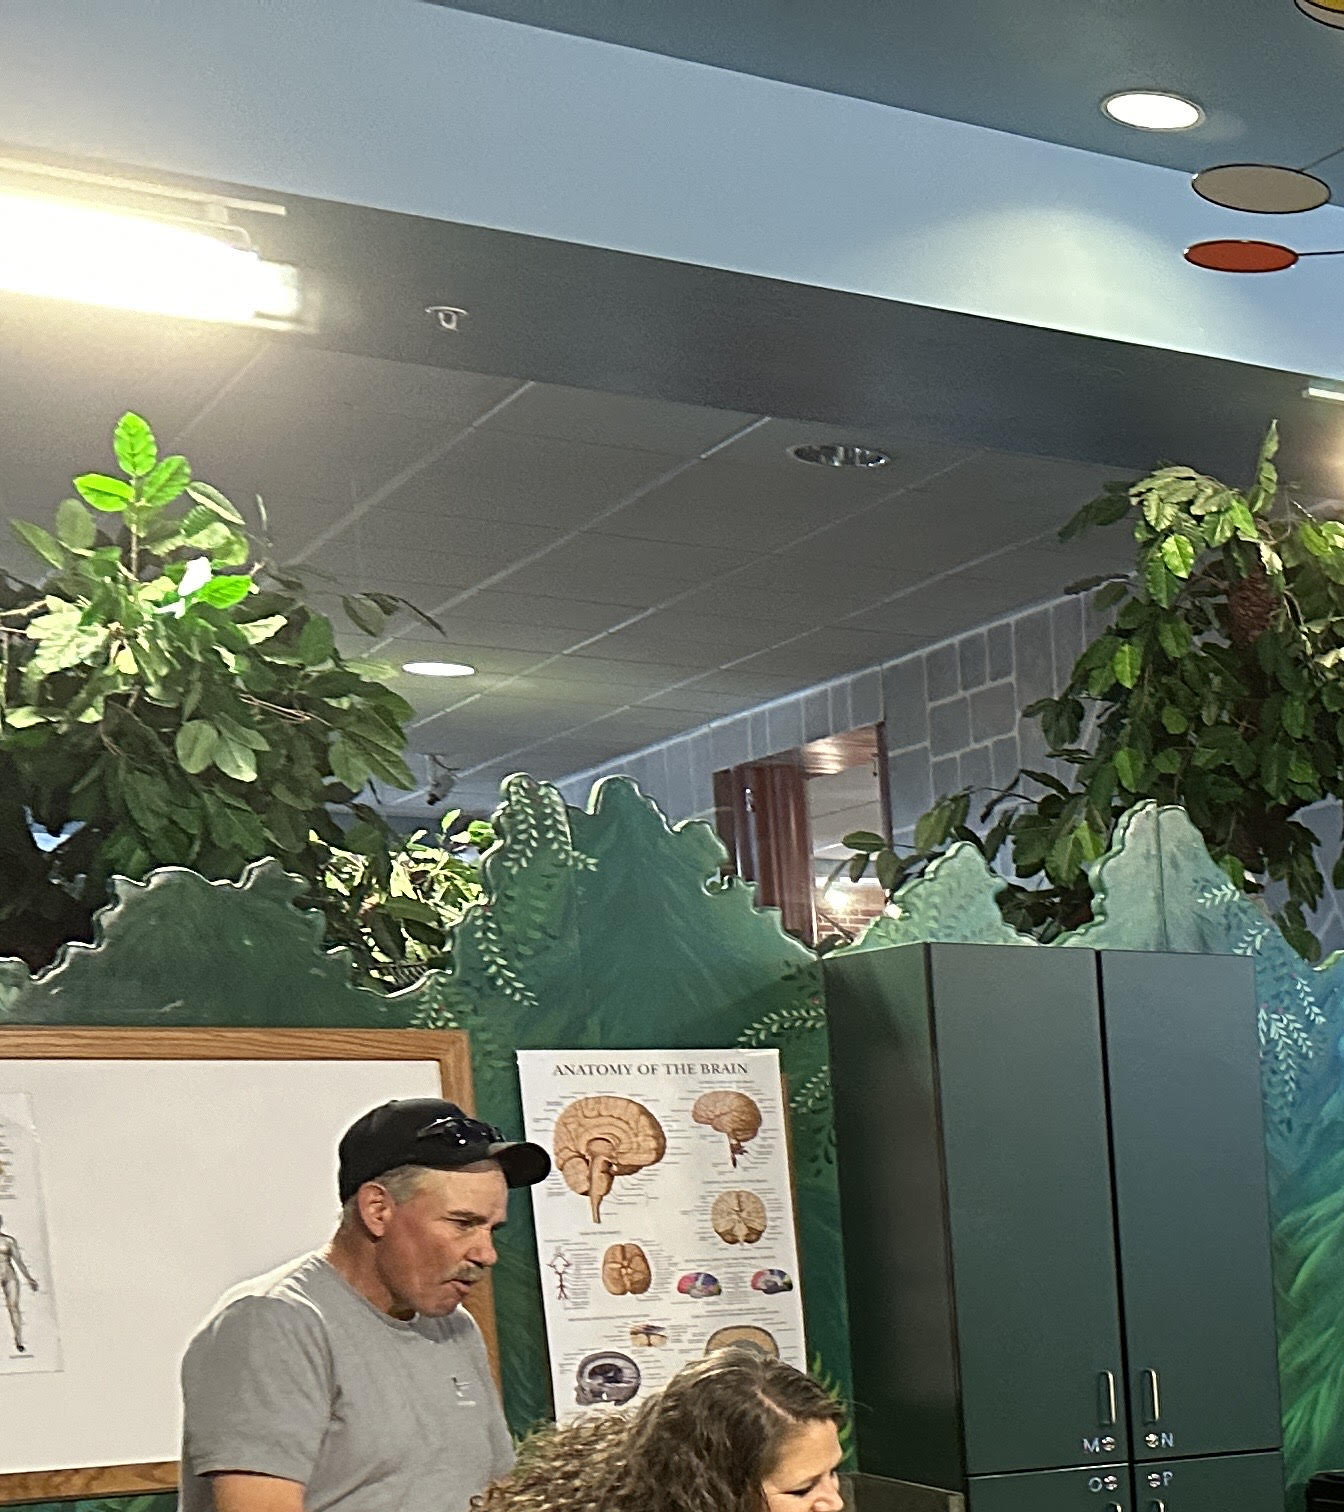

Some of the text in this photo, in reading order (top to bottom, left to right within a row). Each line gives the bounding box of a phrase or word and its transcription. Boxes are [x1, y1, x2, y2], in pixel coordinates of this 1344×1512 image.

[553, 1063, 749, 1077] ANATOMY OF THE BRAIN
[1082, 1437, 1100, 1453] M
[1161, 1432, 1175, 1448] N
[1162, 1470, 1174, 1487] P
